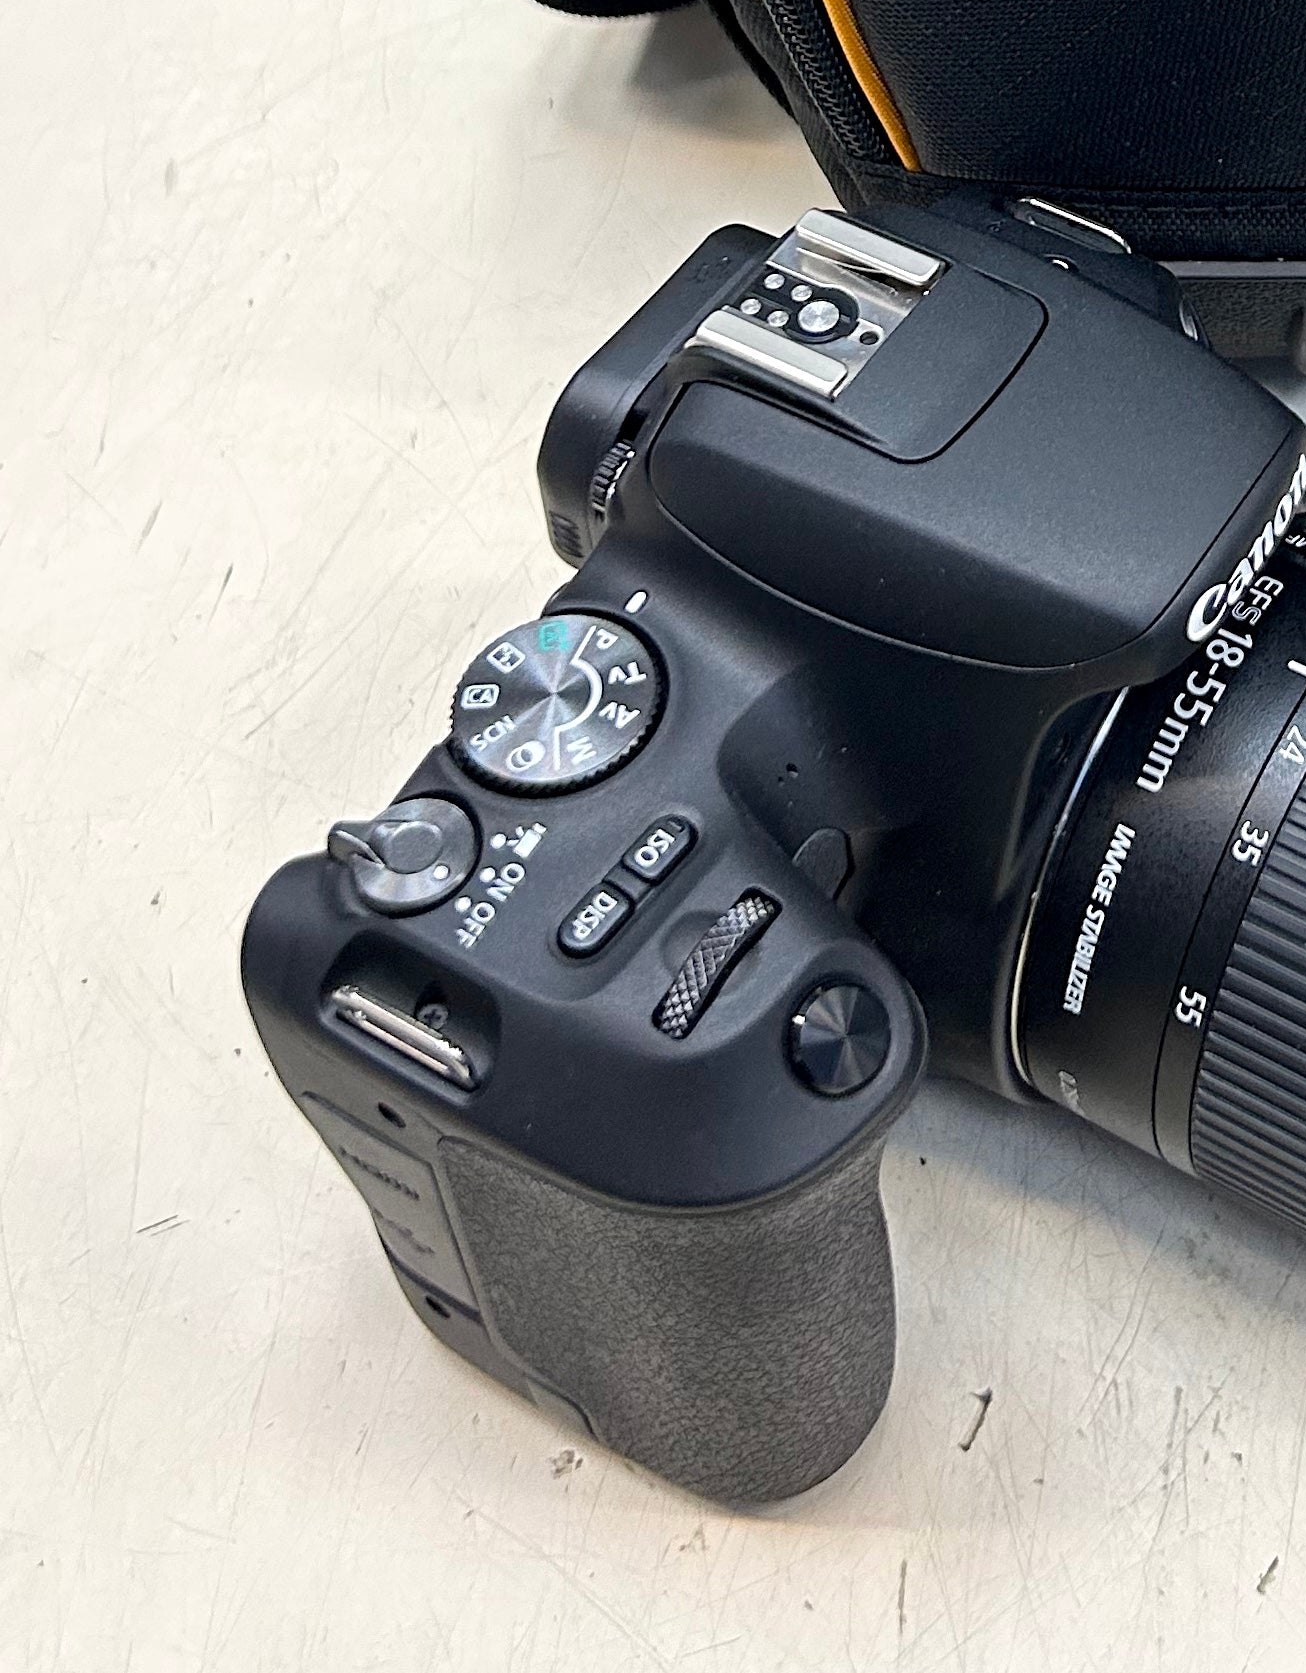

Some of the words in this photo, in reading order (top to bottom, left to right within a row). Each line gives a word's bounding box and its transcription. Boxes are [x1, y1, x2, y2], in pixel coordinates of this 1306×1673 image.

[596, 628, 619, 650] P
[608, 661, 648, 686] Tv
[599, 701, 641, 729] Av
[1136, 627, 1254, 793] 18-55mm
[469, 714, 518, 753] SCN
[566, 736, 598, 766] M
[634, 829, 677, 868] ISO
[1231, 820, 1270, 867] 35
[486, 863, 526, 903] ON
[1091, 823, 1136, 907] IMAGE
[455, 902, 497, 949] OFF
[571, 891, 619, 941] DISP
[1063, 903, 1106, 1015] STABILIZER
[1175, 985, 1207, 1029] 55
